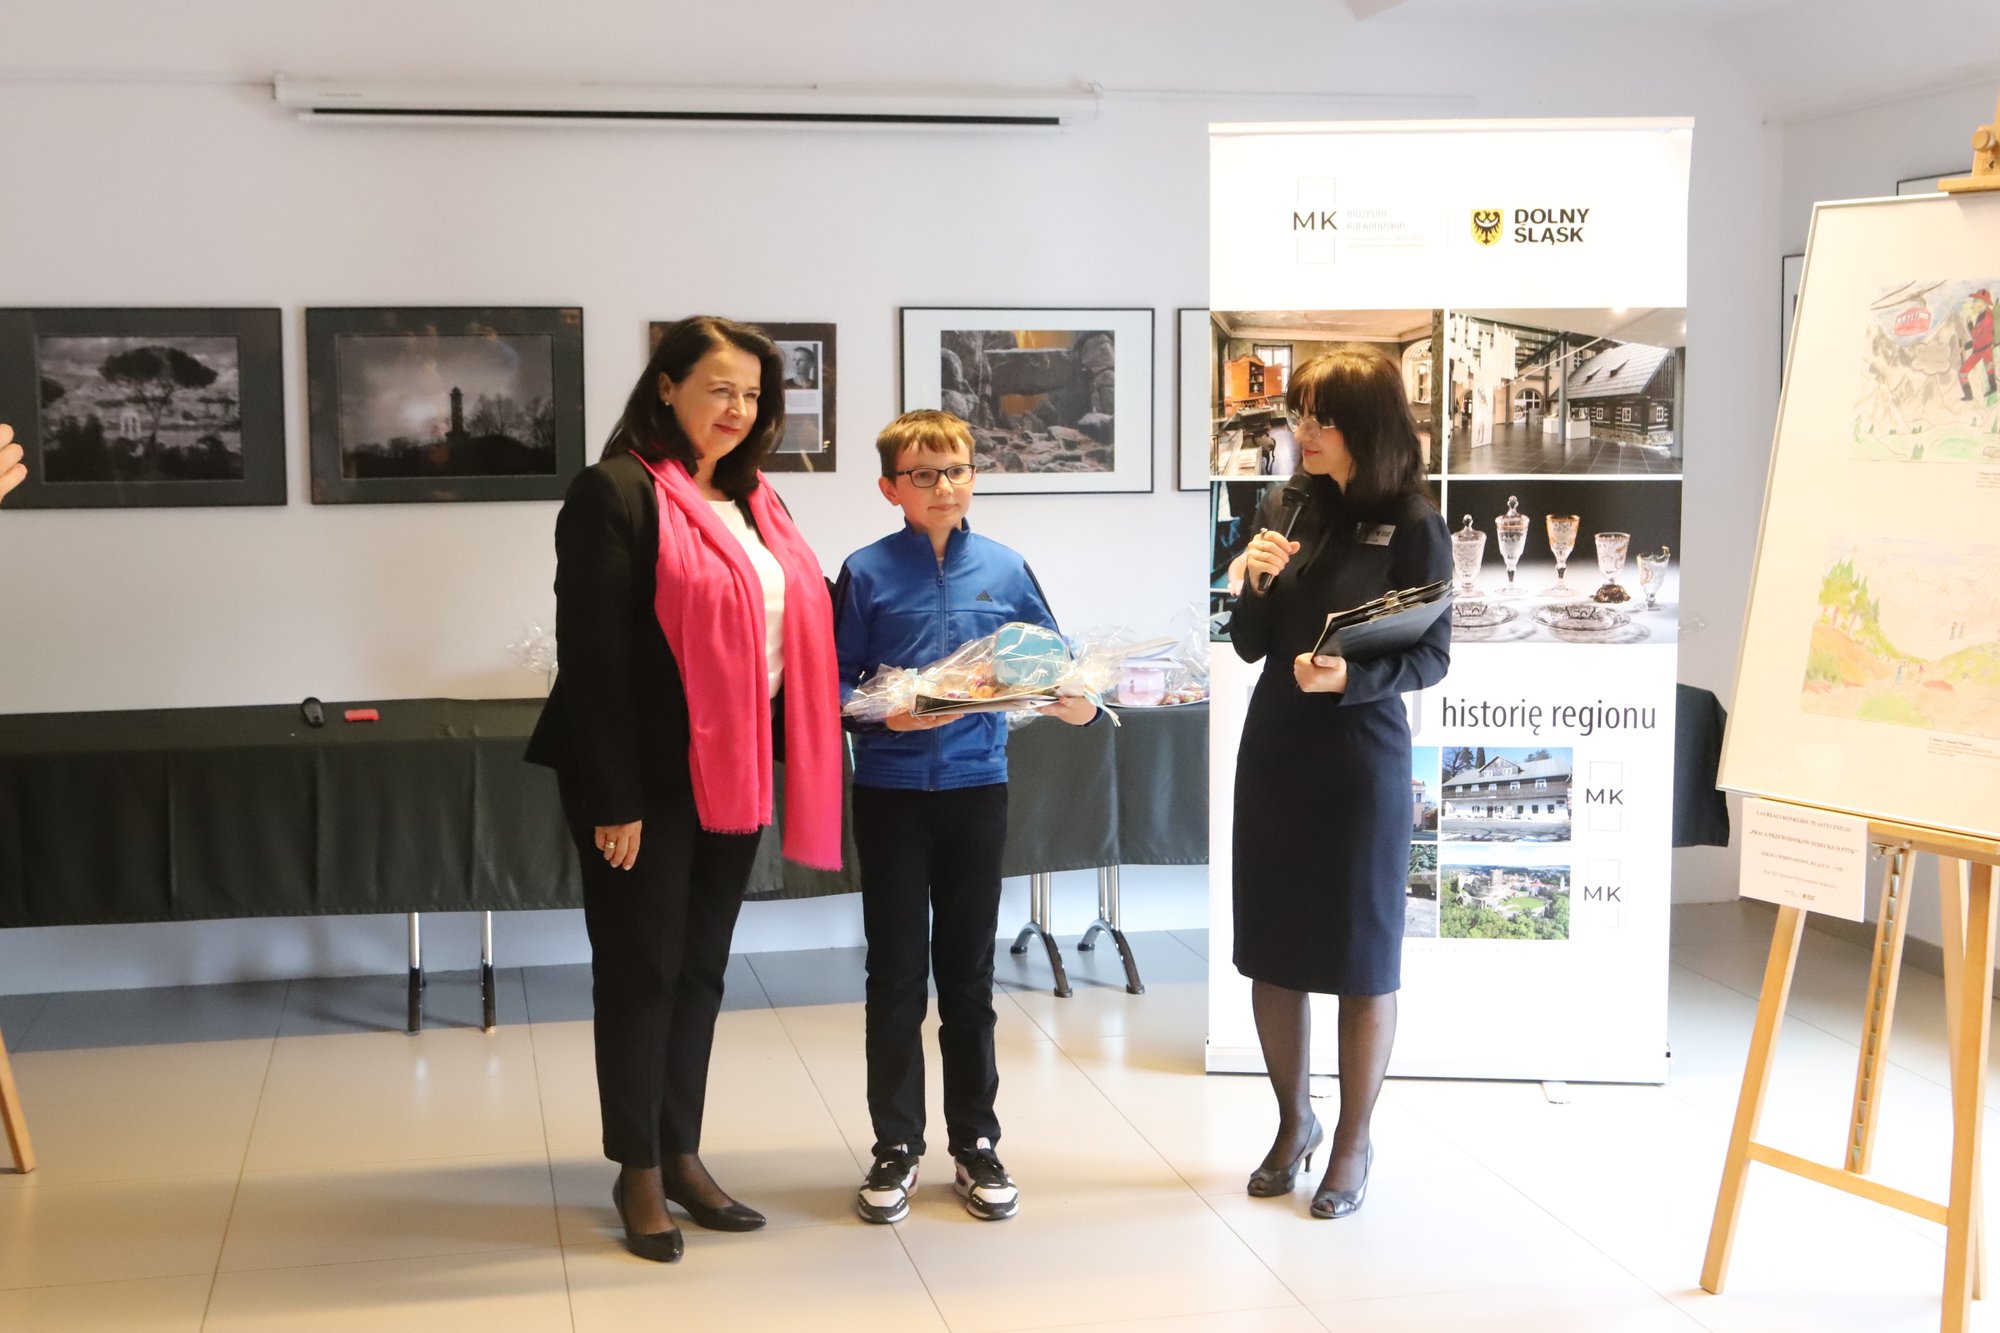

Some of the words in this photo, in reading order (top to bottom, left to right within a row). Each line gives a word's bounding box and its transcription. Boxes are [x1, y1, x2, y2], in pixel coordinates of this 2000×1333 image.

[1293, 211, 1338, 231] MK
[1514, 208, 1590, 225] DOLNY
[1514, 223, 1584, 246] ŚLĄSK
[1442, 696, 1543, 736] historię
[1552, 699, 1656, 737] regionu
[1585, 788, 1624, 805] MK
[1584, 885, 1621, 903] MK
